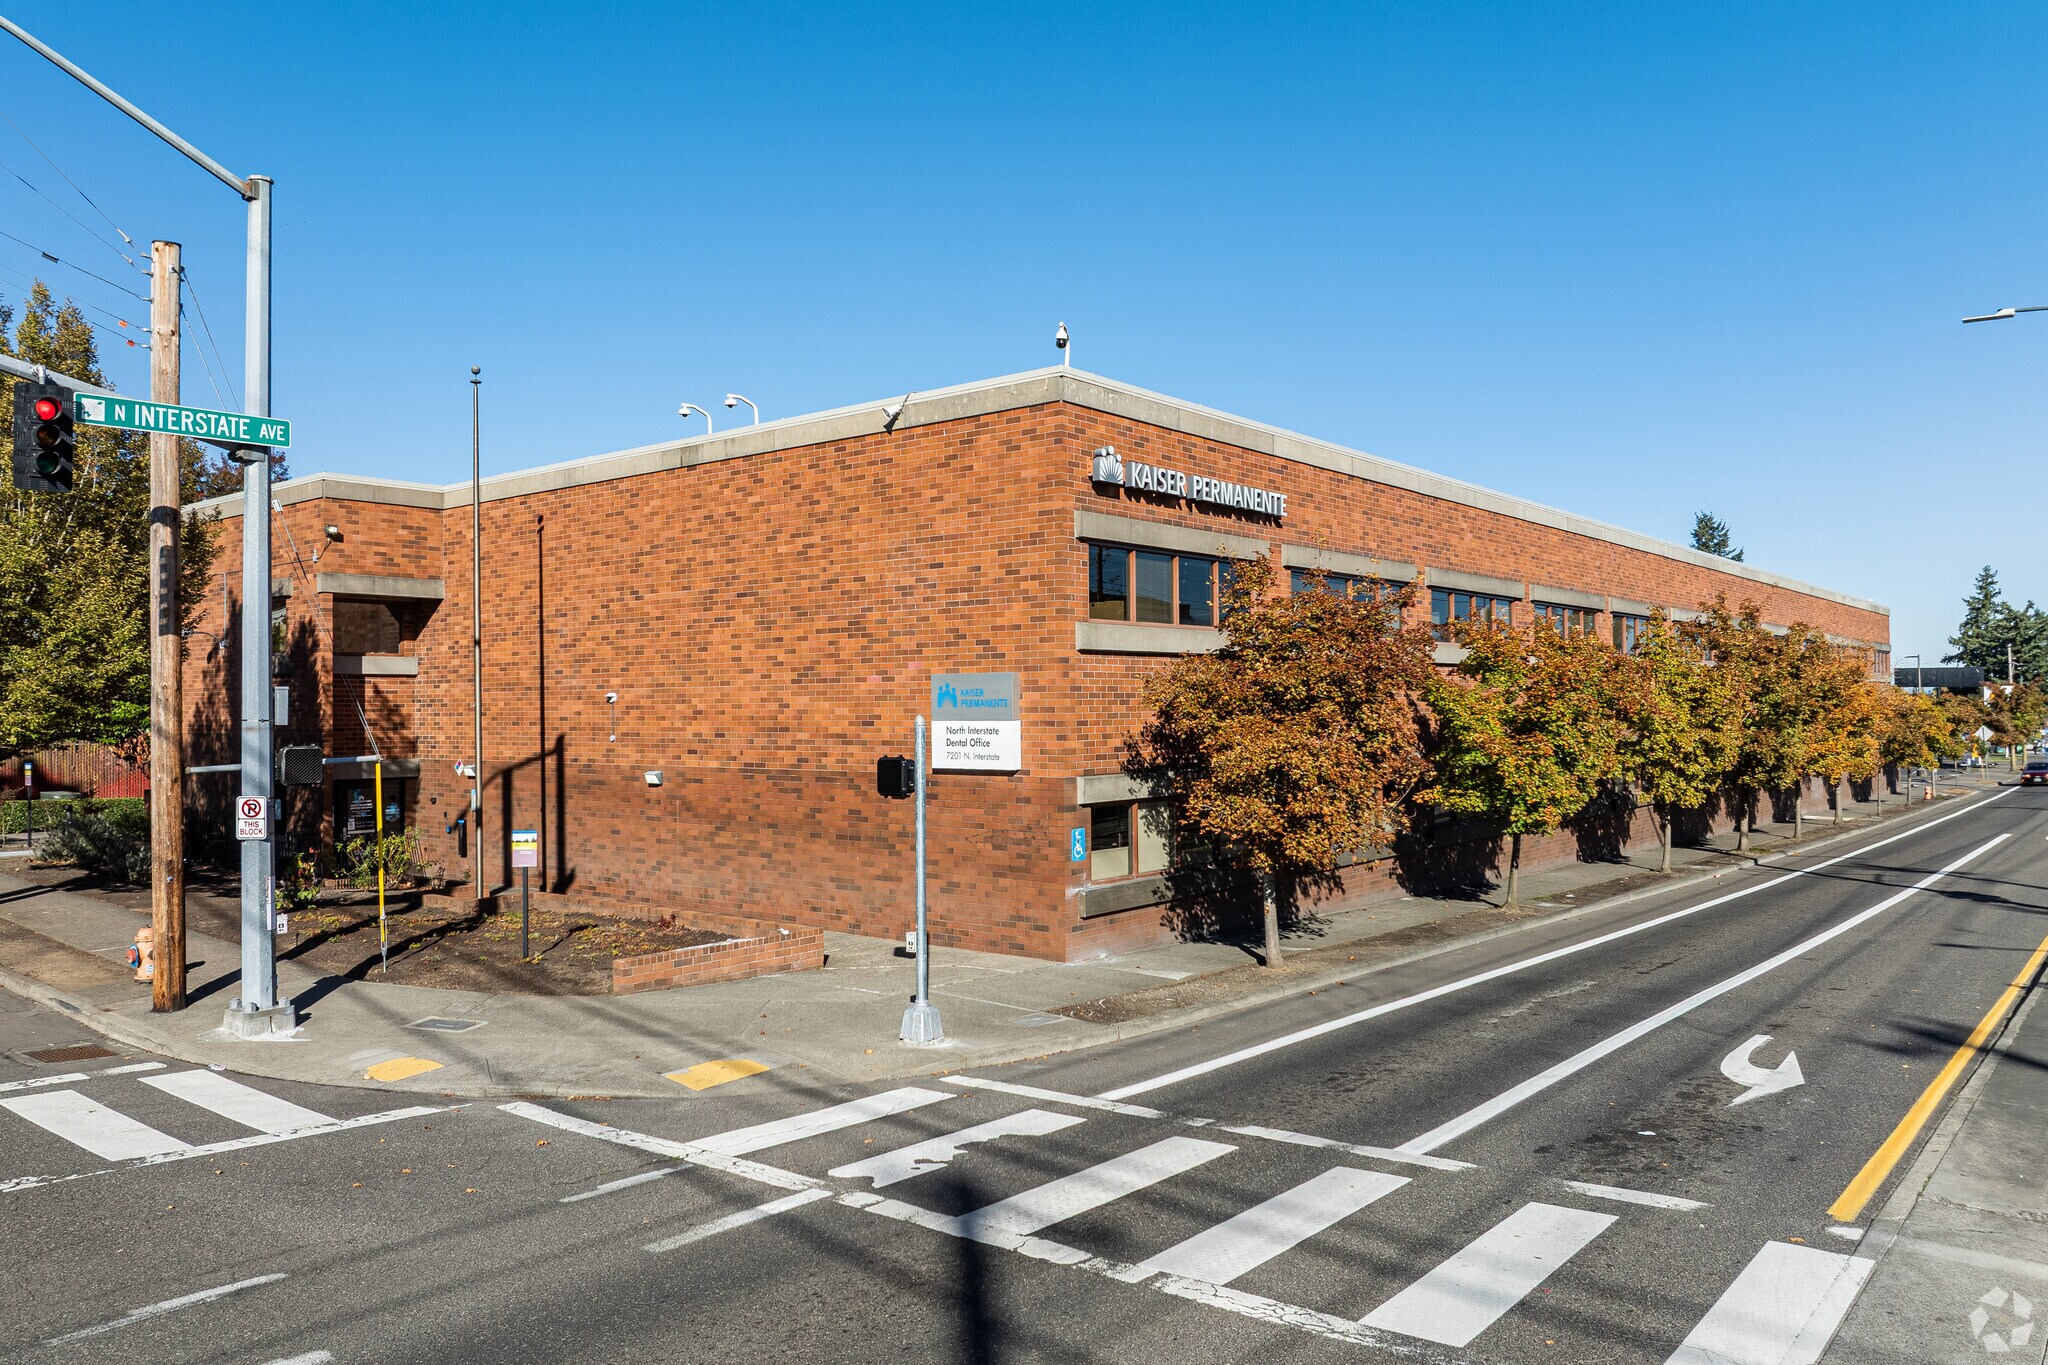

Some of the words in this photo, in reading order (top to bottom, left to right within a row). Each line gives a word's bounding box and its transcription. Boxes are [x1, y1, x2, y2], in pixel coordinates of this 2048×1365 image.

[114, 404, 126, 421] N
[134, 404, 251, 439] INTERSTATE
[259, 423, 286, 441] AVE
[1127, 461, 1187, 497] KAISER
[1189, 475, 1288, 517] PERMANENTE
[960, 688, 984, 697] KAISER
[960, 698, 1008, 708] PERMANENTE
[946, 726, 966, 735] North
[967, 726, 1000, 735] Interstate
[946, 738, 968, 747] Dental
[969, 738, 991, 747] Office
[946, 752, 961, 760] 7201
[973, 753, 1000, 761] Interstate
